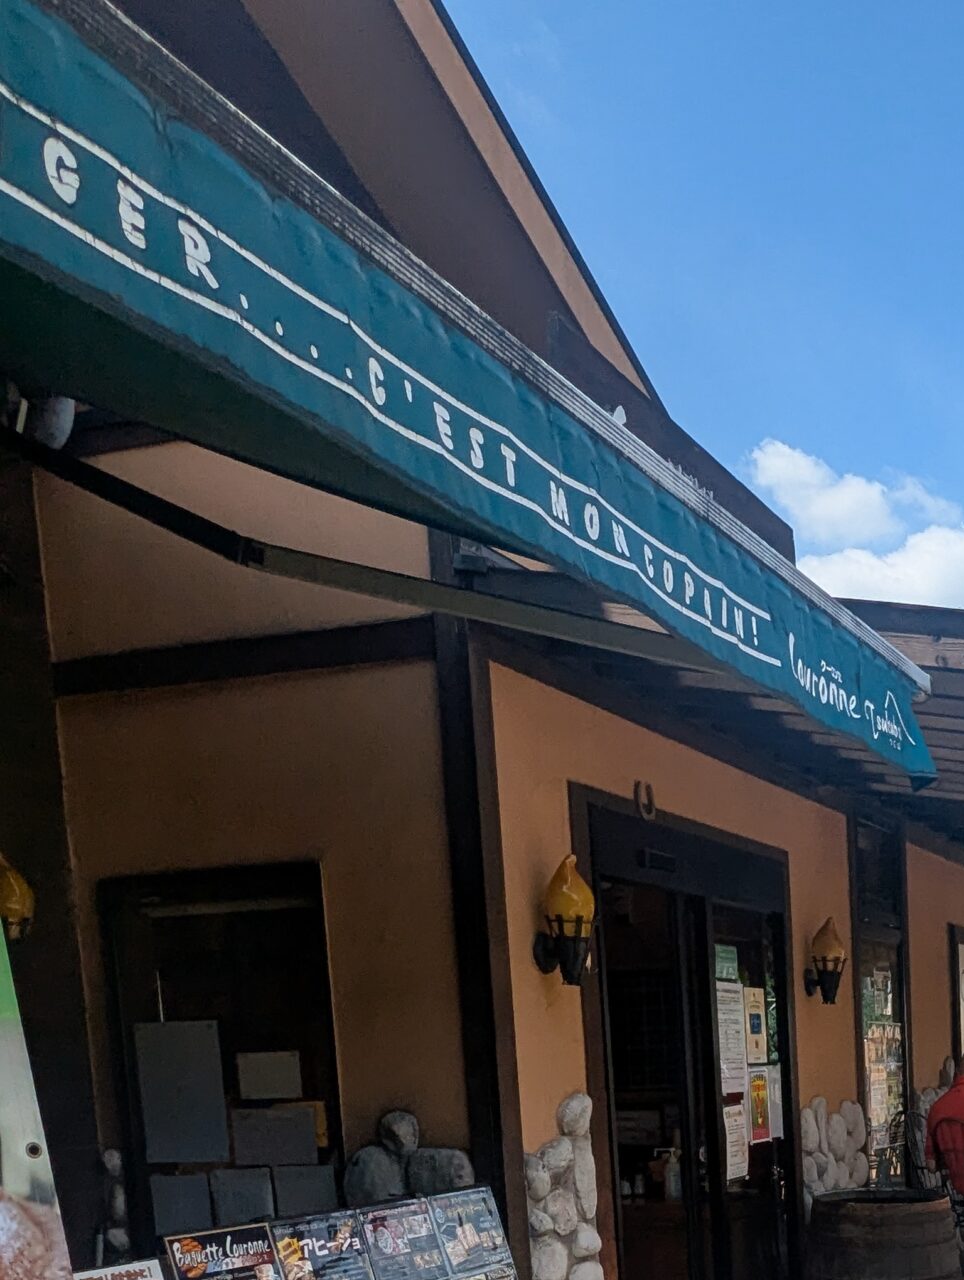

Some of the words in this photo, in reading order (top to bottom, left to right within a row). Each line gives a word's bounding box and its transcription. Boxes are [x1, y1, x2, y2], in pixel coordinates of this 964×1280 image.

[549, 480, 629, 560] MON
[643, 544, 759, 647] COPAIN!
[172, 1241, 225, 1268] Baguette
[226, 1235, 271, 1257] Couronne
